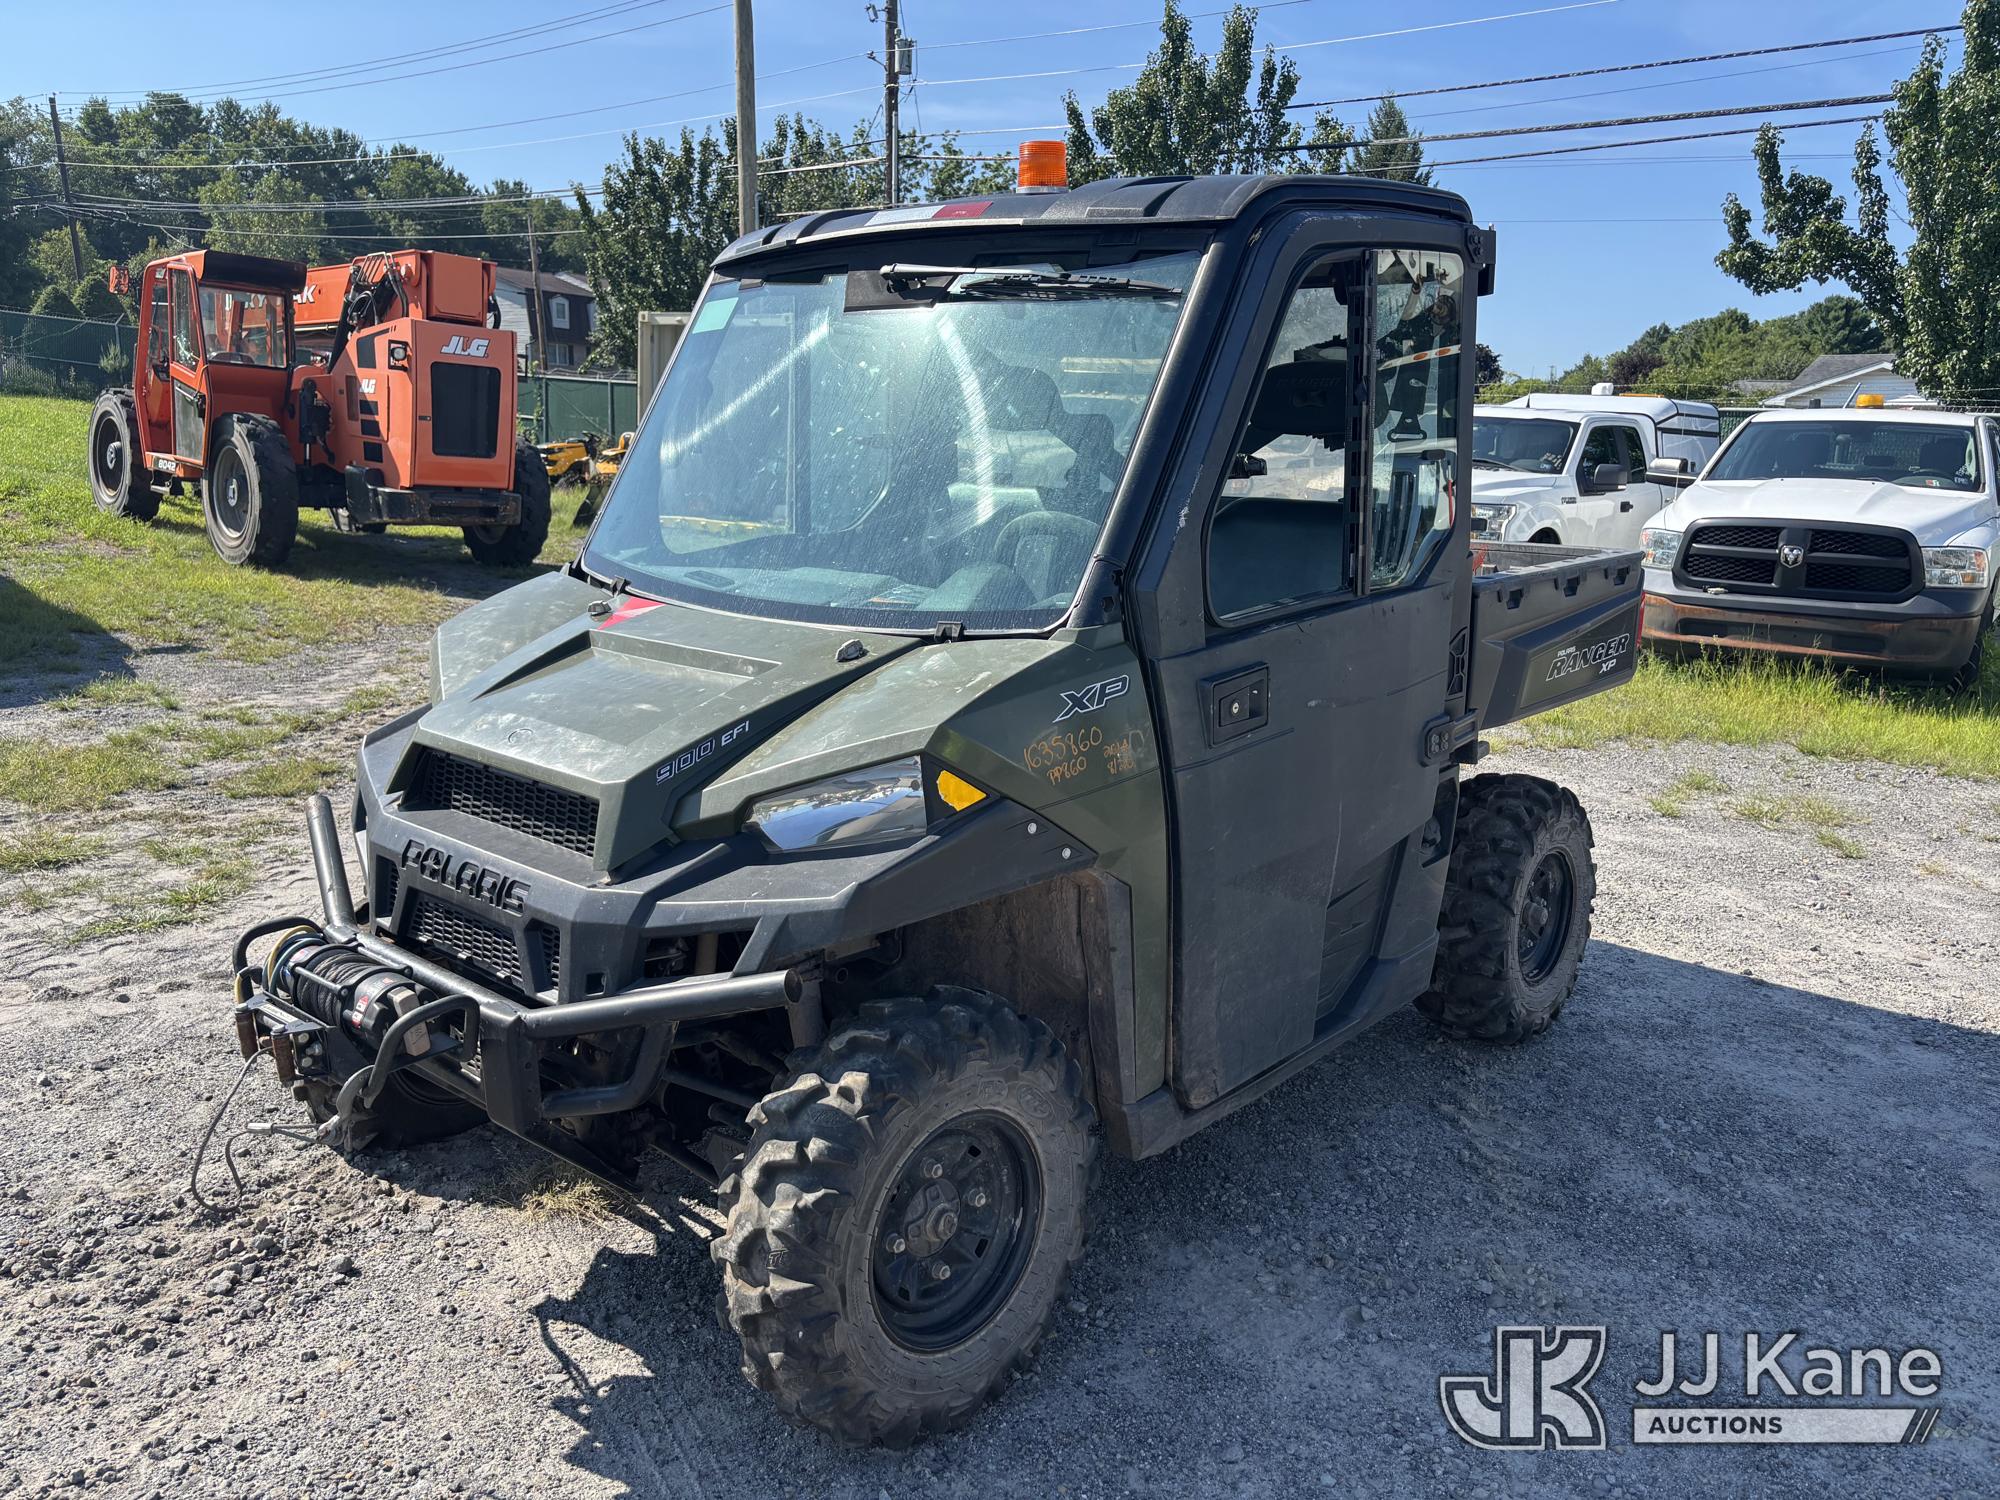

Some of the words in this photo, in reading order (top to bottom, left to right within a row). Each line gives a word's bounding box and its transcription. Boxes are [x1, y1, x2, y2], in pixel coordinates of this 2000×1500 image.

[440, 335, 489, 358] JLG
[359, 378, 376, 394] JLG
[1546, 633, 1629, 681] RANGER
[1599, 659, 1616, 674] XP
[1052, 674, 1130, 723] XP
[656, 737, 716, 786] 900
[721, 720, 750, 747] EFI
[400, 838, 532, 918] POLARIS
